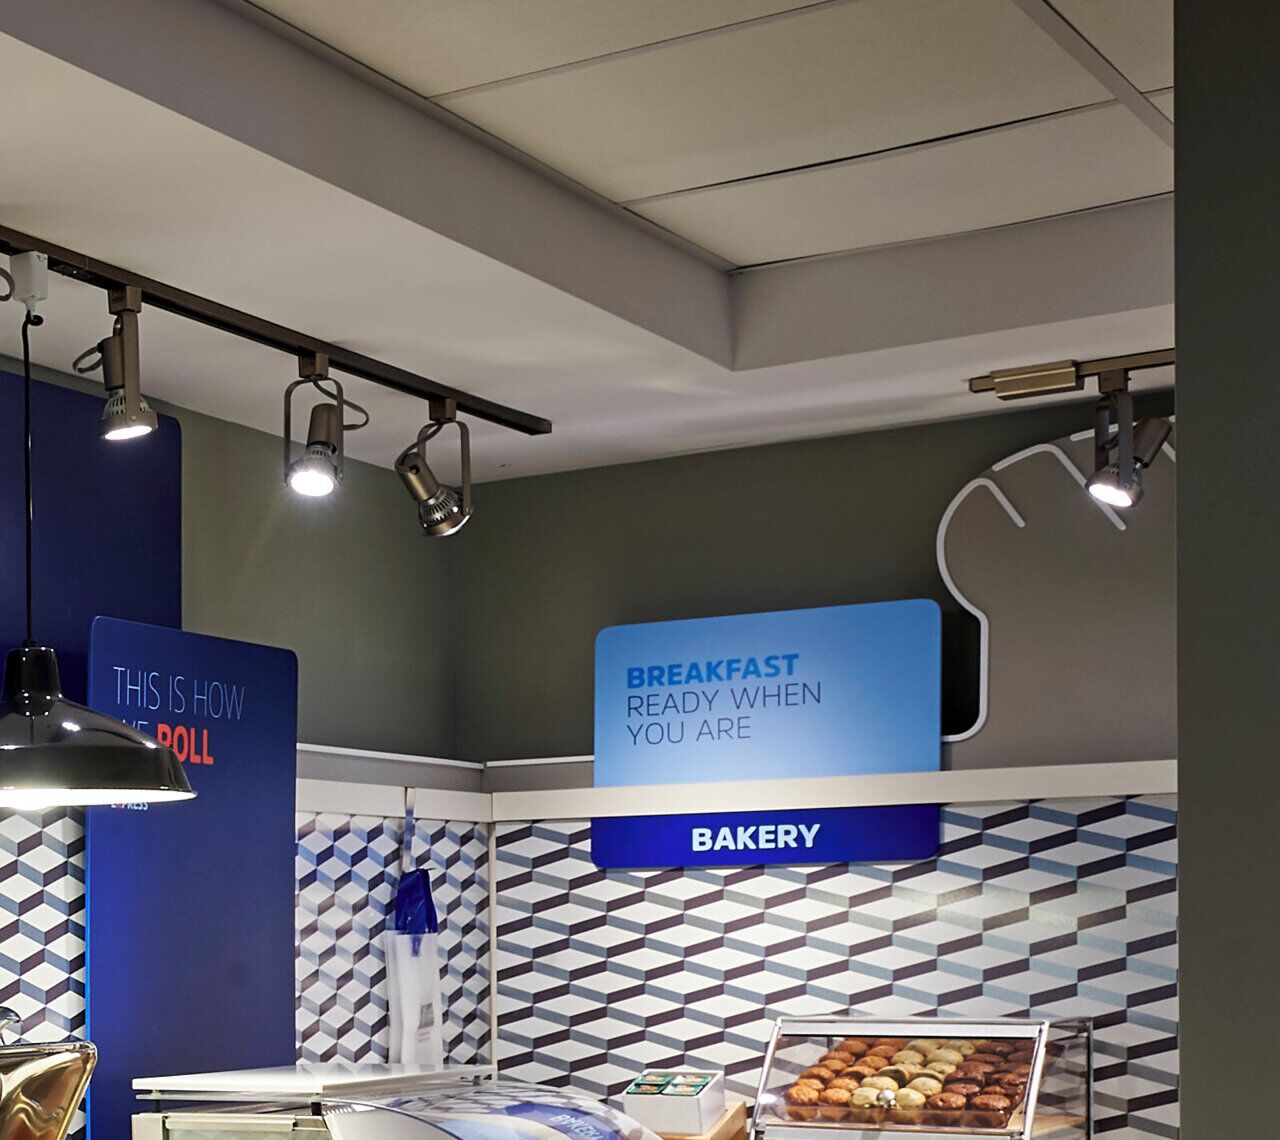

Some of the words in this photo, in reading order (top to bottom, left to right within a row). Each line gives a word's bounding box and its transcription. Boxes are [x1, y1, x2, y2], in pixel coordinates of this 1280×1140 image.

[626, 652, 800, 690] BREAKFAST
[112, 666, 161, 710] THIS
[168, 675, 185, 714] IS
[193, 679, 246, 720] HOW
[626, 687, 720, 718] READY
[730, 680, 822, 711] WHEN
[626, 720, 685, 747] YOU
[695, 715, 752, 742] ARE
[691, 823, 821, 853] BAKERY
